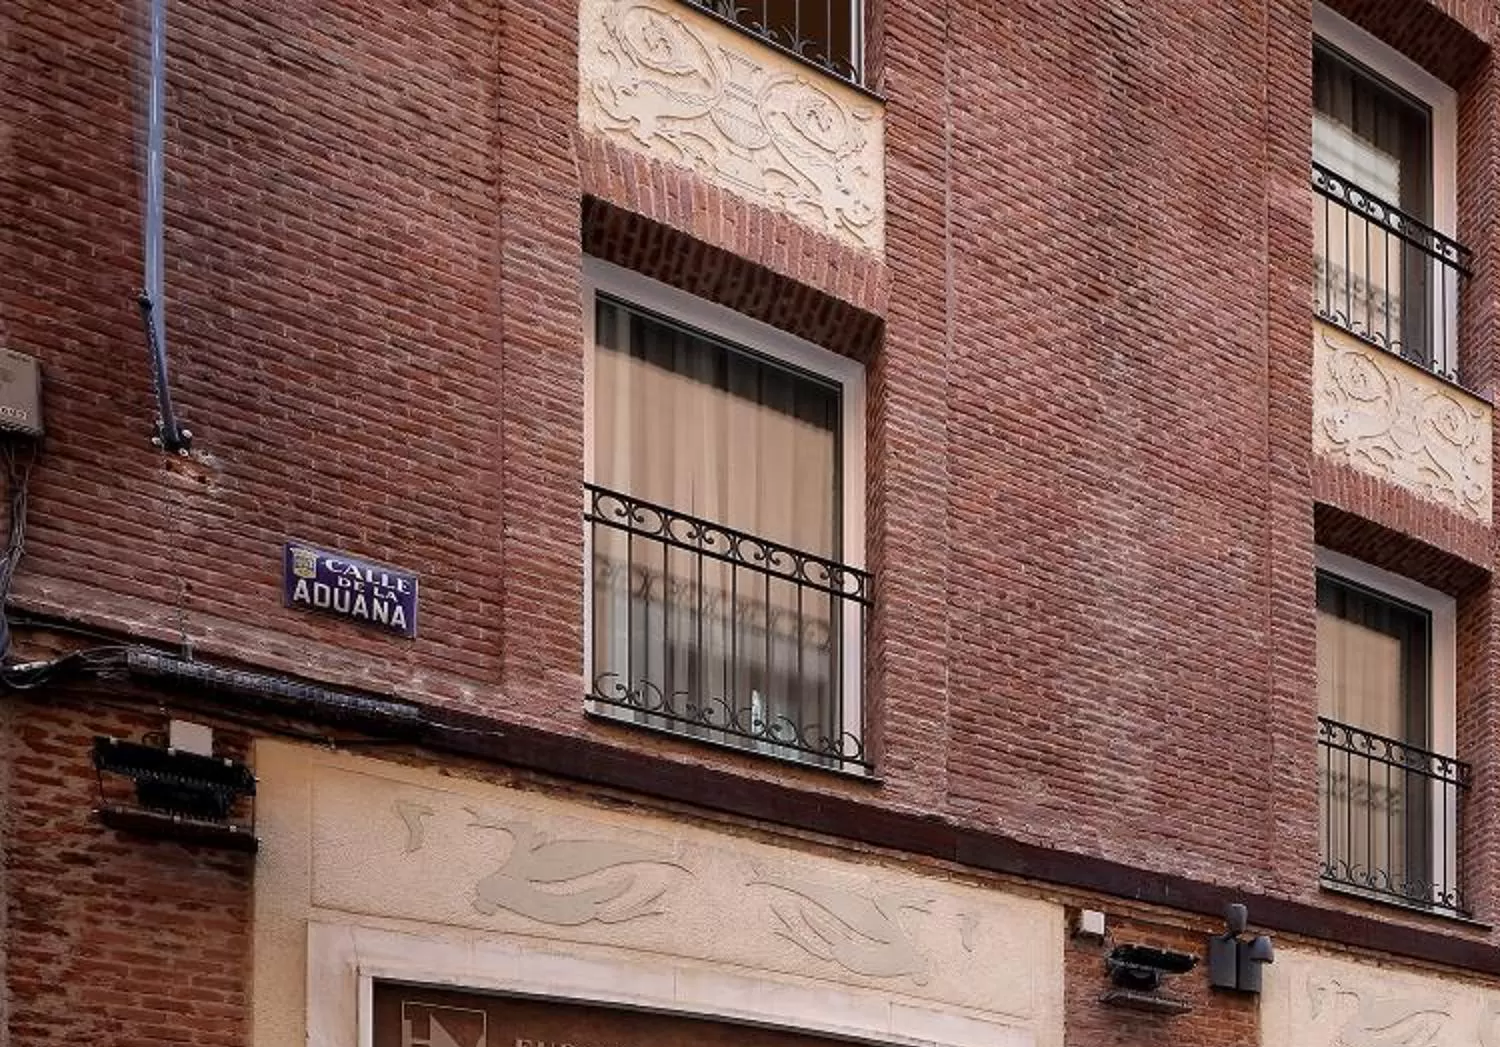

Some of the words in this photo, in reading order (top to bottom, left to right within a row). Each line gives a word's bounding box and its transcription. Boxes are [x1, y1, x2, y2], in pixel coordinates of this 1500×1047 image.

[325, 558, 412, 595] CALLE
[373, 586, 399, 603] LA
[293, 578, 407, 629] ADUANA
